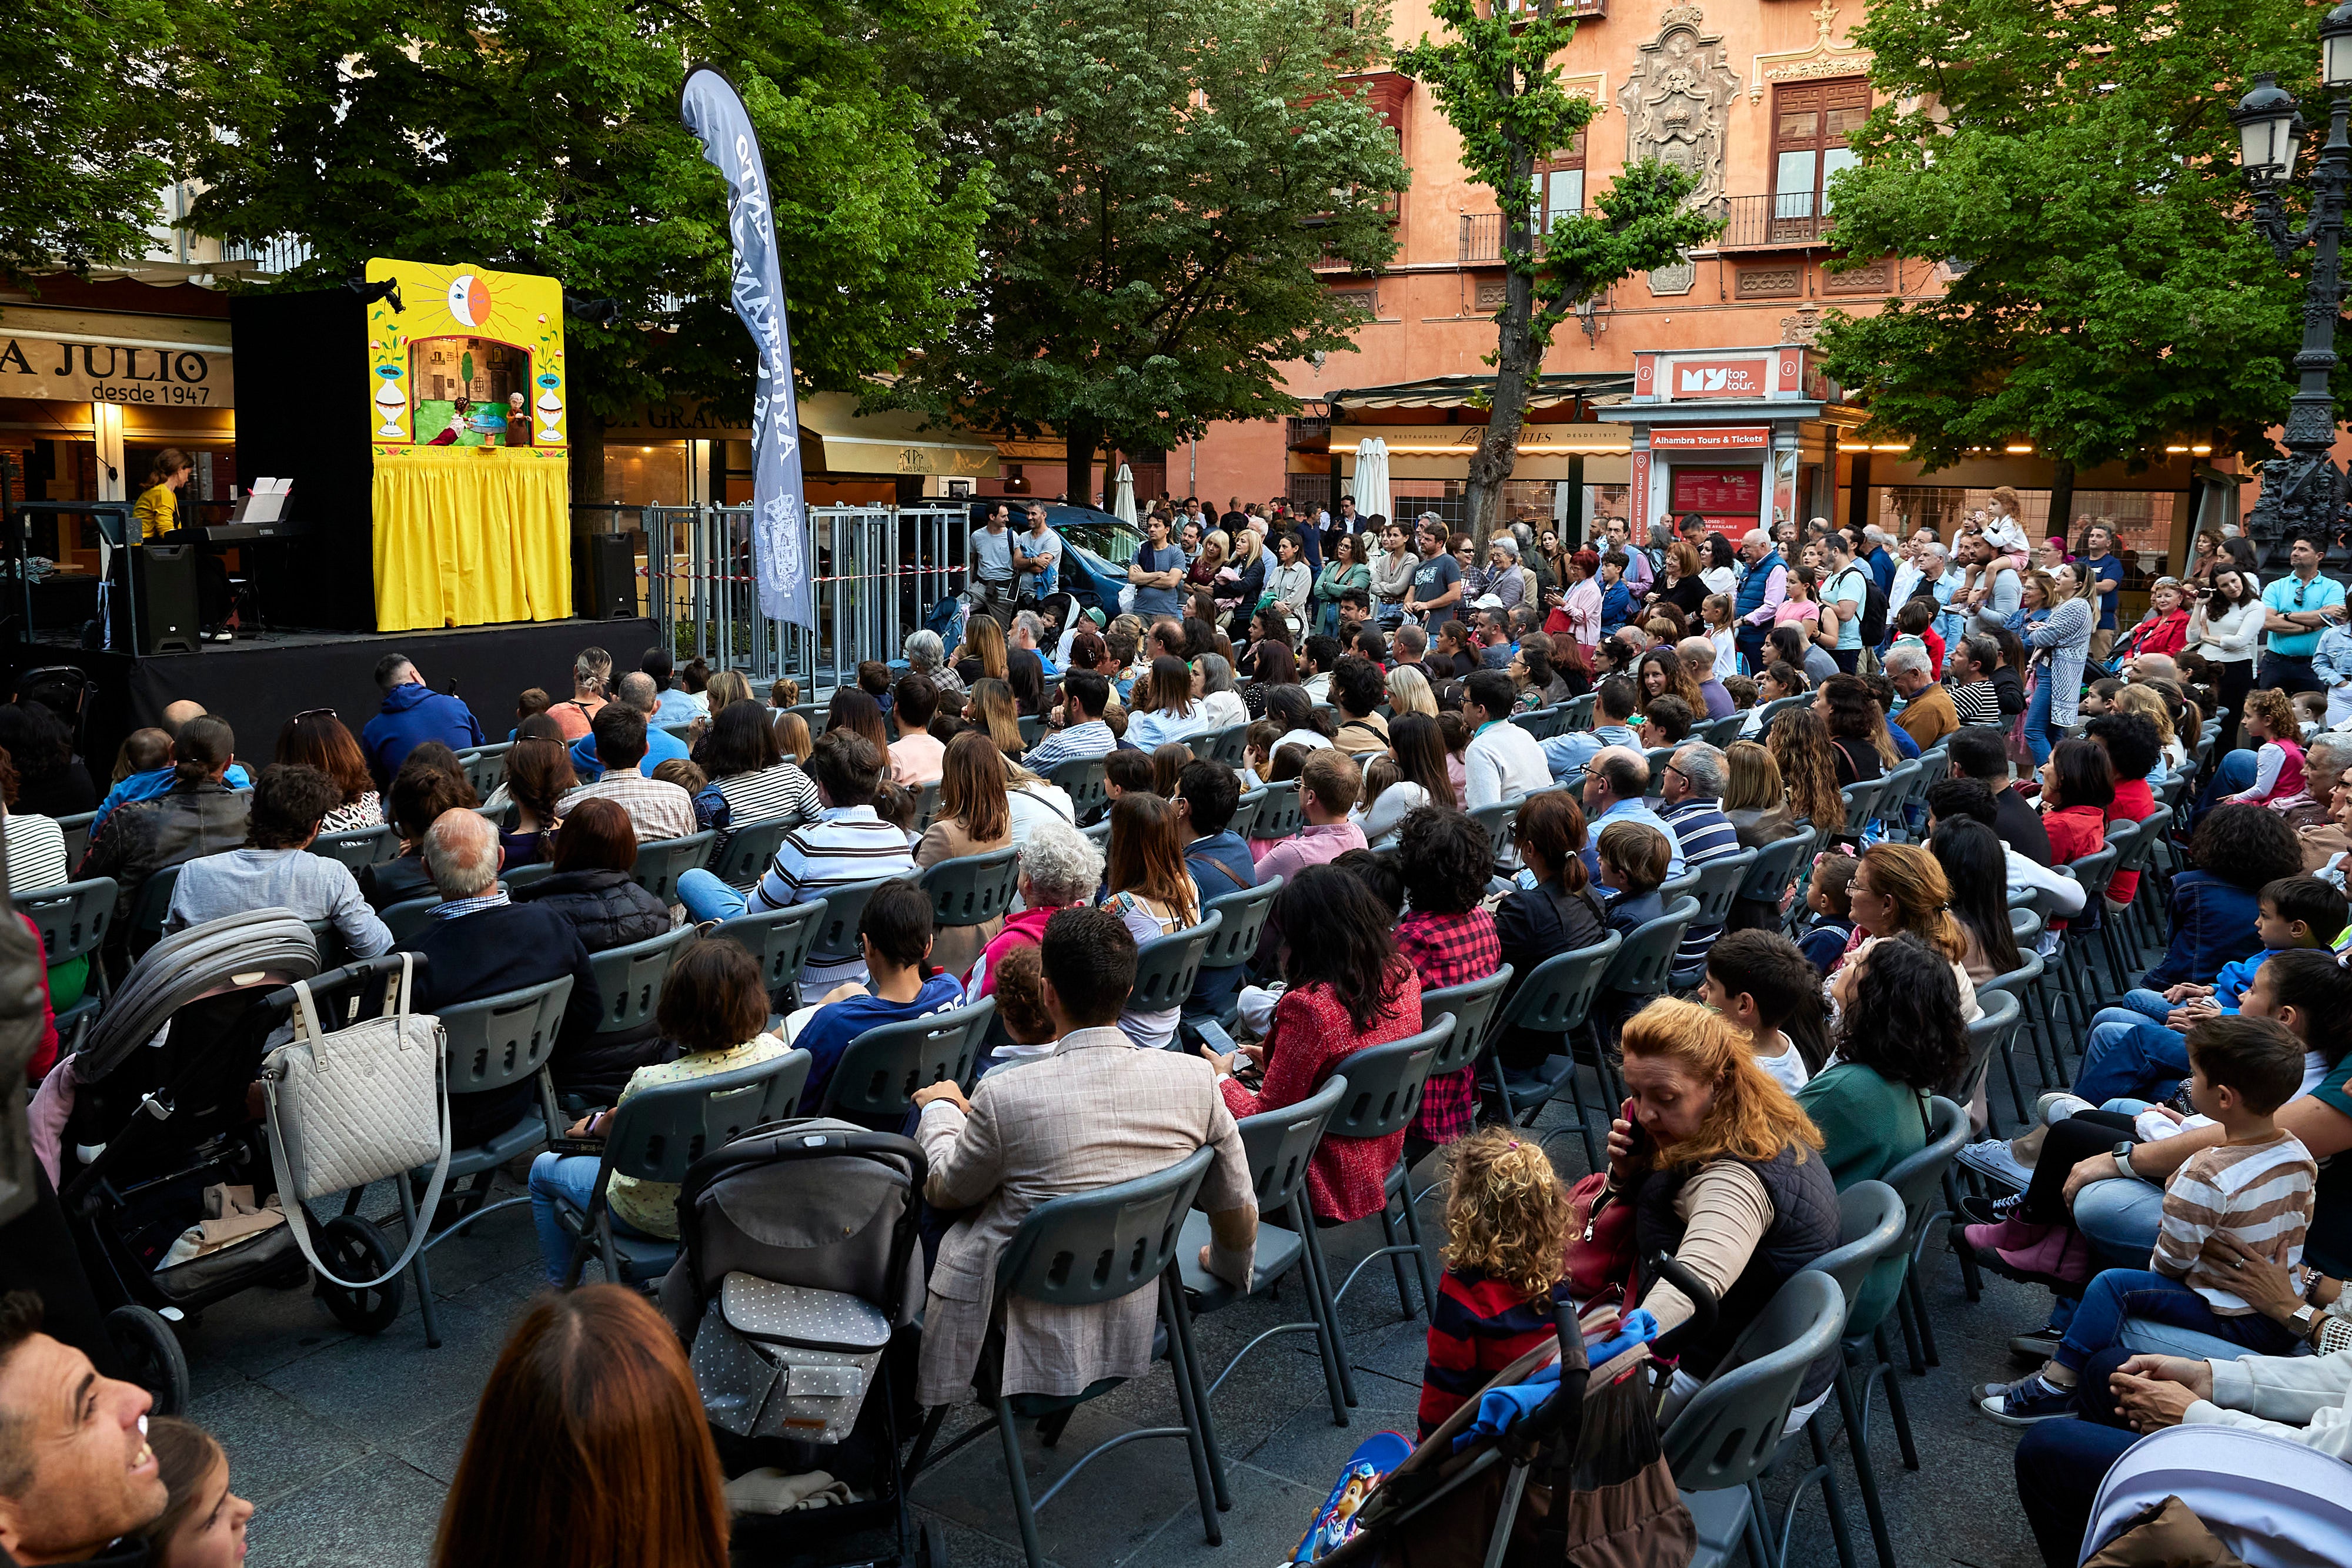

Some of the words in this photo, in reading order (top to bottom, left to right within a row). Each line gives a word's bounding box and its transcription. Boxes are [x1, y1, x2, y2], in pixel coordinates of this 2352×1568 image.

[55, 342, 208, 383] JULIO
[1728, 367, 1748, 382] top
[92, 380, 155, 403] desde
[161, 386, 210, 404] 1947
[1727, 379, 1756, 390] tour.
[1451, 427, 1479, 446] Los
[413, 446, 452, 457] RETABLO
[460, 447, 470, 457] DE
